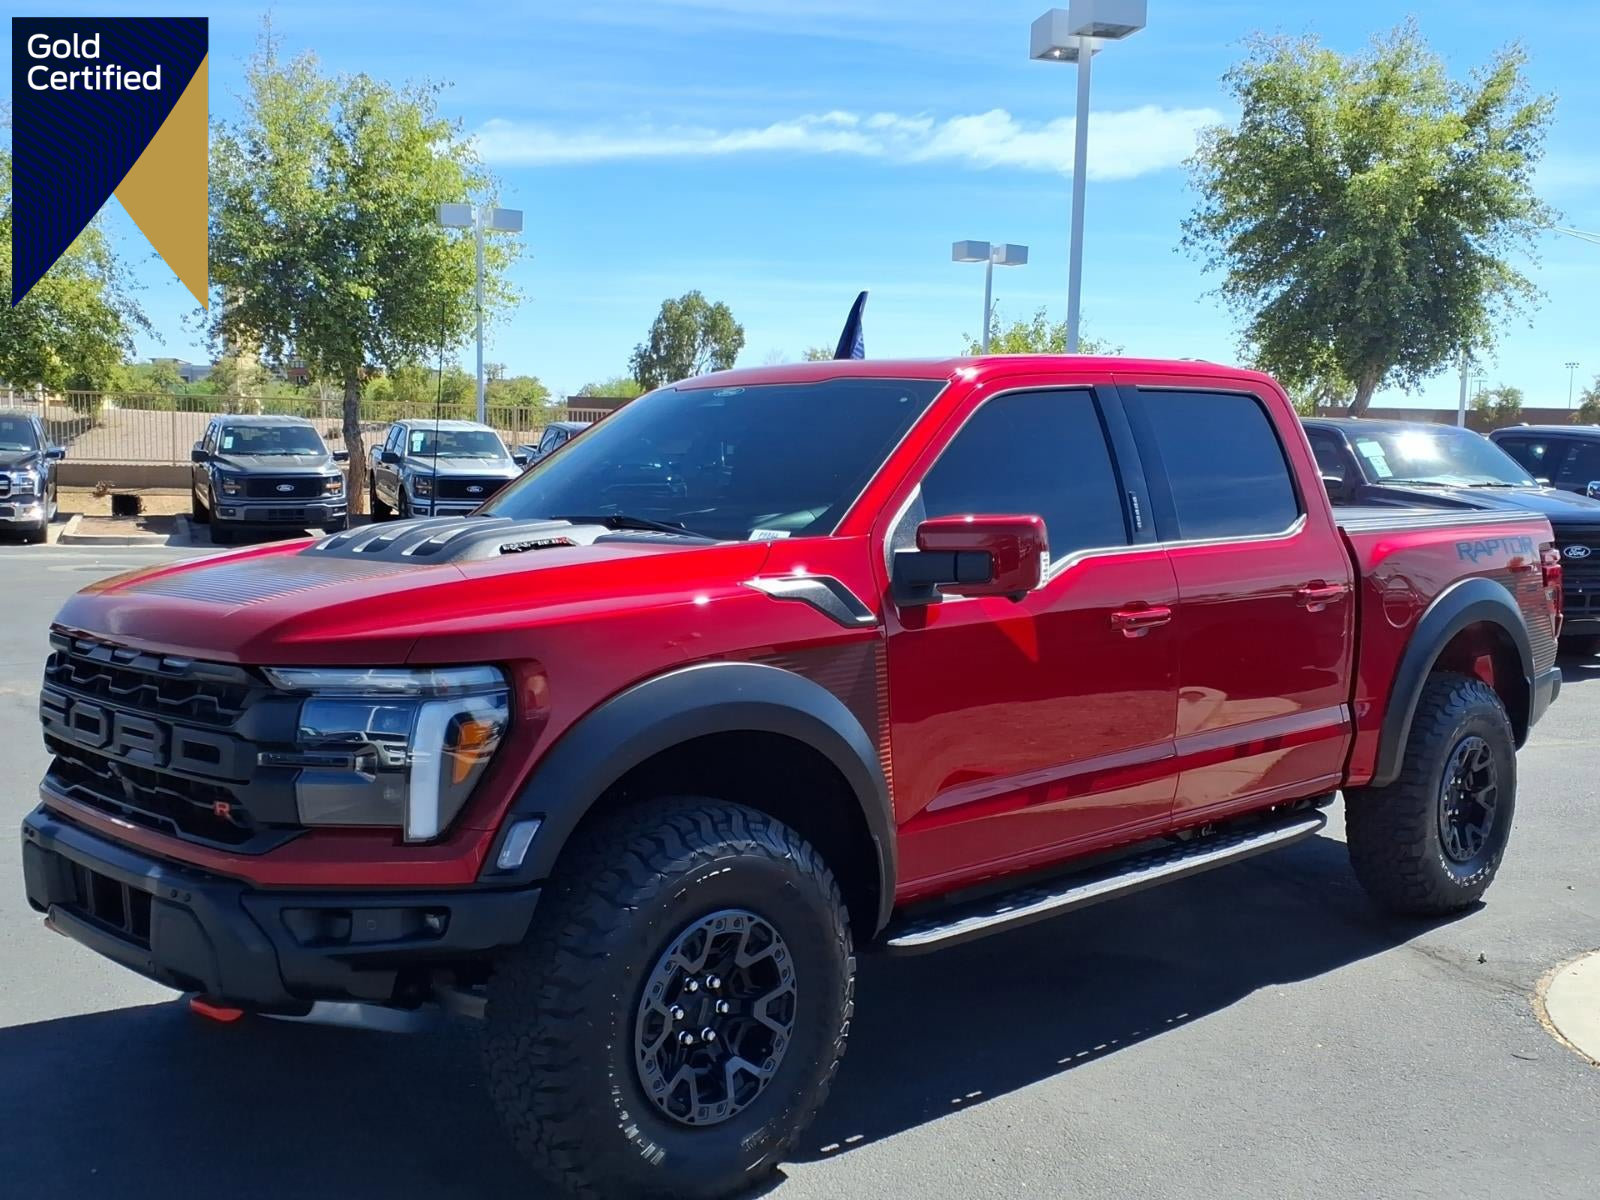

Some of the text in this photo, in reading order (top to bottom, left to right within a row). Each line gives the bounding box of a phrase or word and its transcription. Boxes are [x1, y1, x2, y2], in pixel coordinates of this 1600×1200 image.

[1456, 536, 1536, 563] RAPTOR
[39, 688, 240, 779] FORD
[213, 801, 230, 817] R
